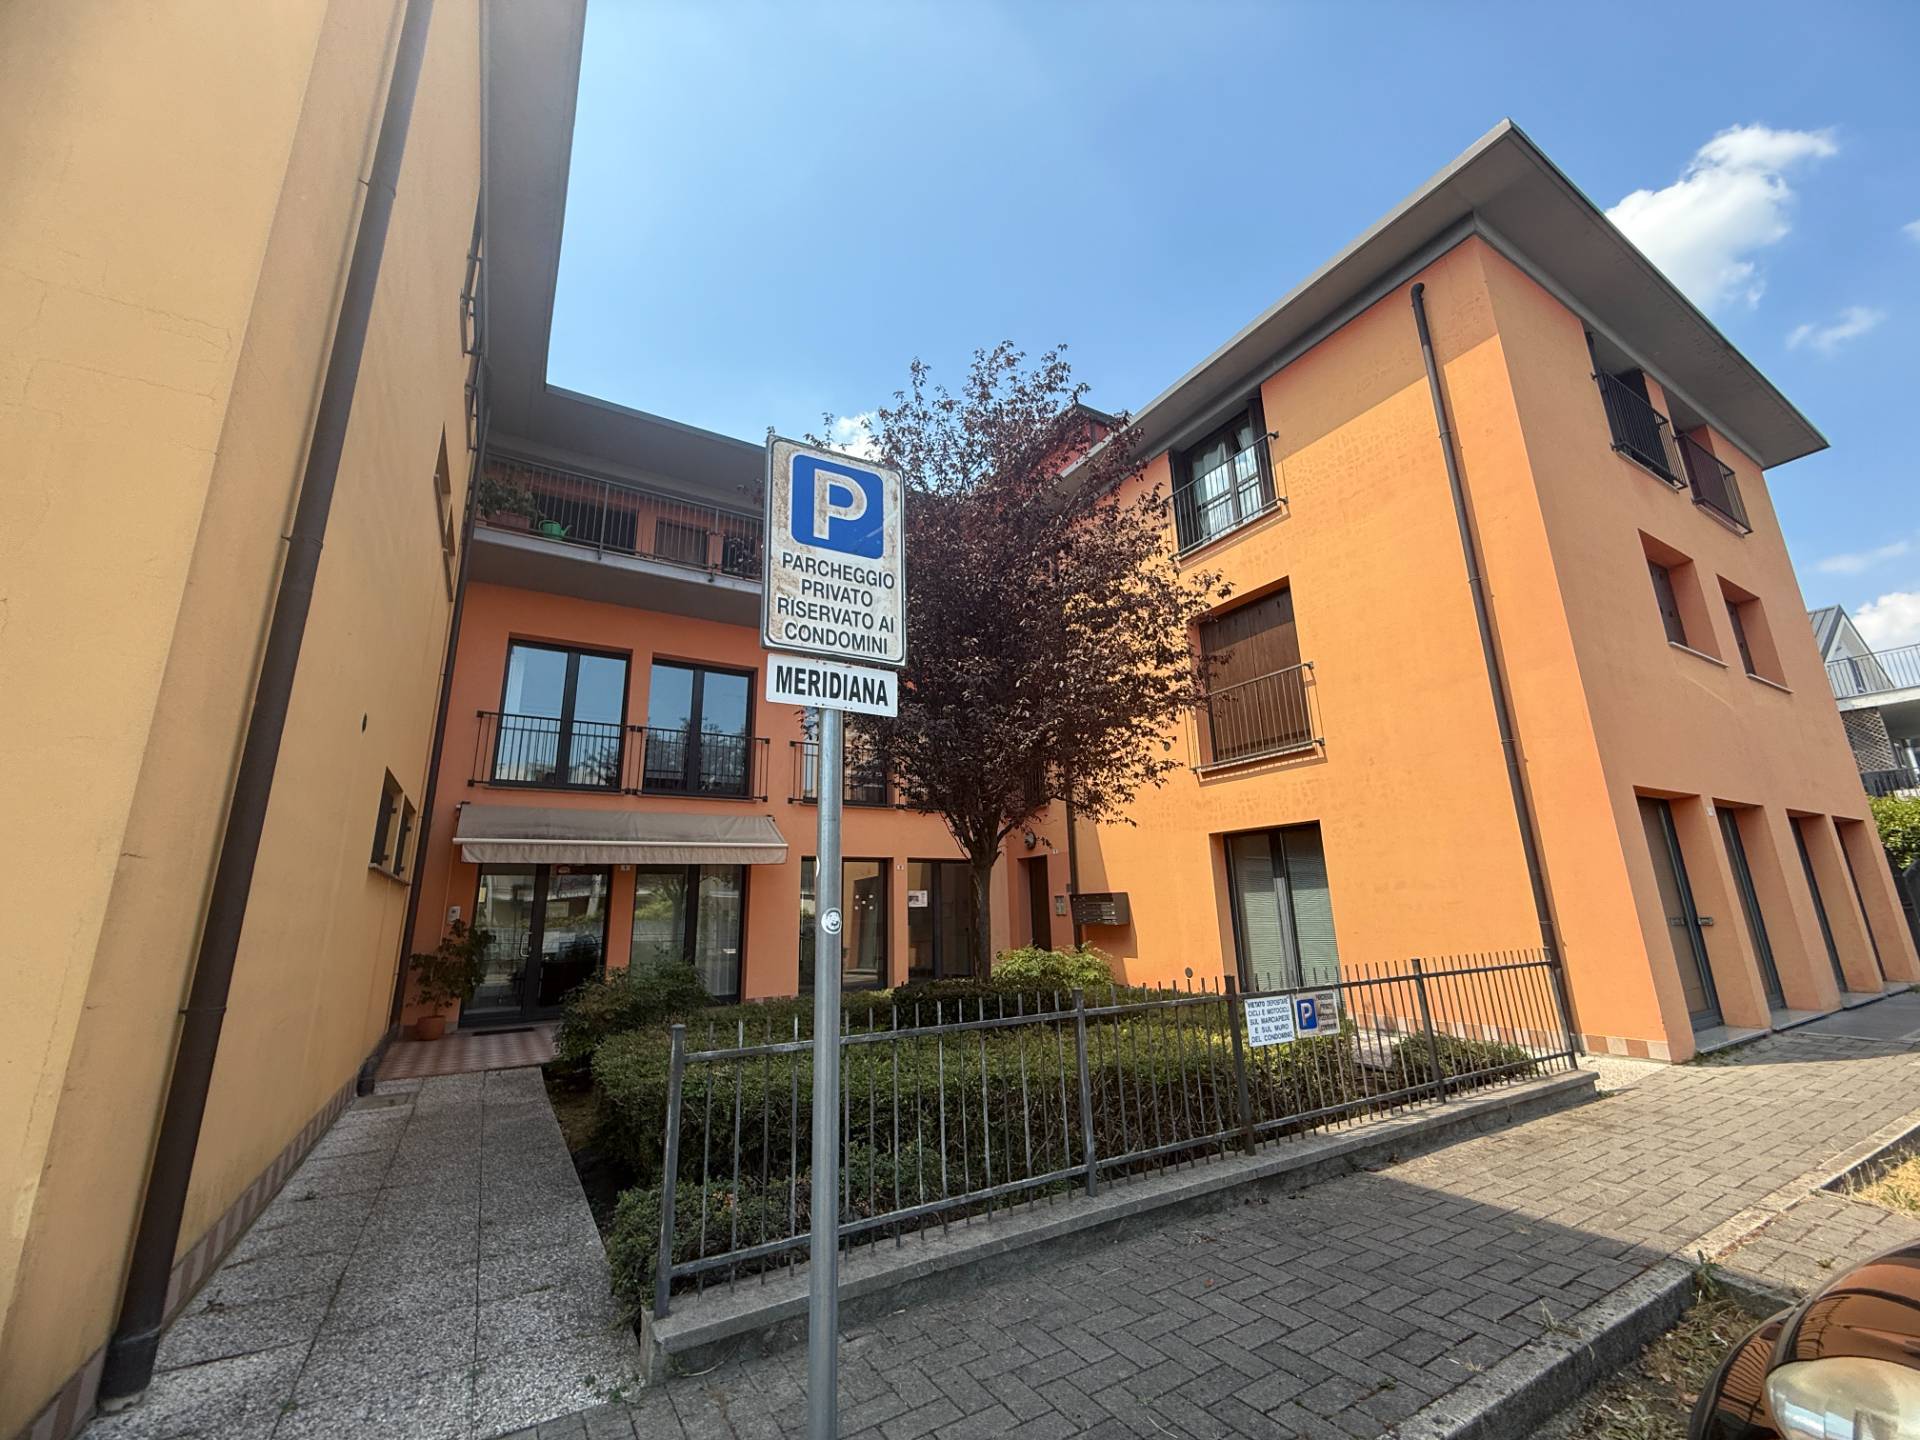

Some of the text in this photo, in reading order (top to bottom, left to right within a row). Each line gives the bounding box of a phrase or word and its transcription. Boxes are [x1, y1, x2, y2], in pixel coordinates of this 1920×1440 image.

[814, 469, 867, 540] P
[782, 552, 895, 589] PARCHEGGIO
[801, 579, 873, 607] PRIVATO
[777, 597, 894, 633] RISERVATO AI
[785, 623, 888, 655] CONDOMINI
[776, 665, 889, 706] MERIDIANA
[1300, 1003, 1312, 1027] P
